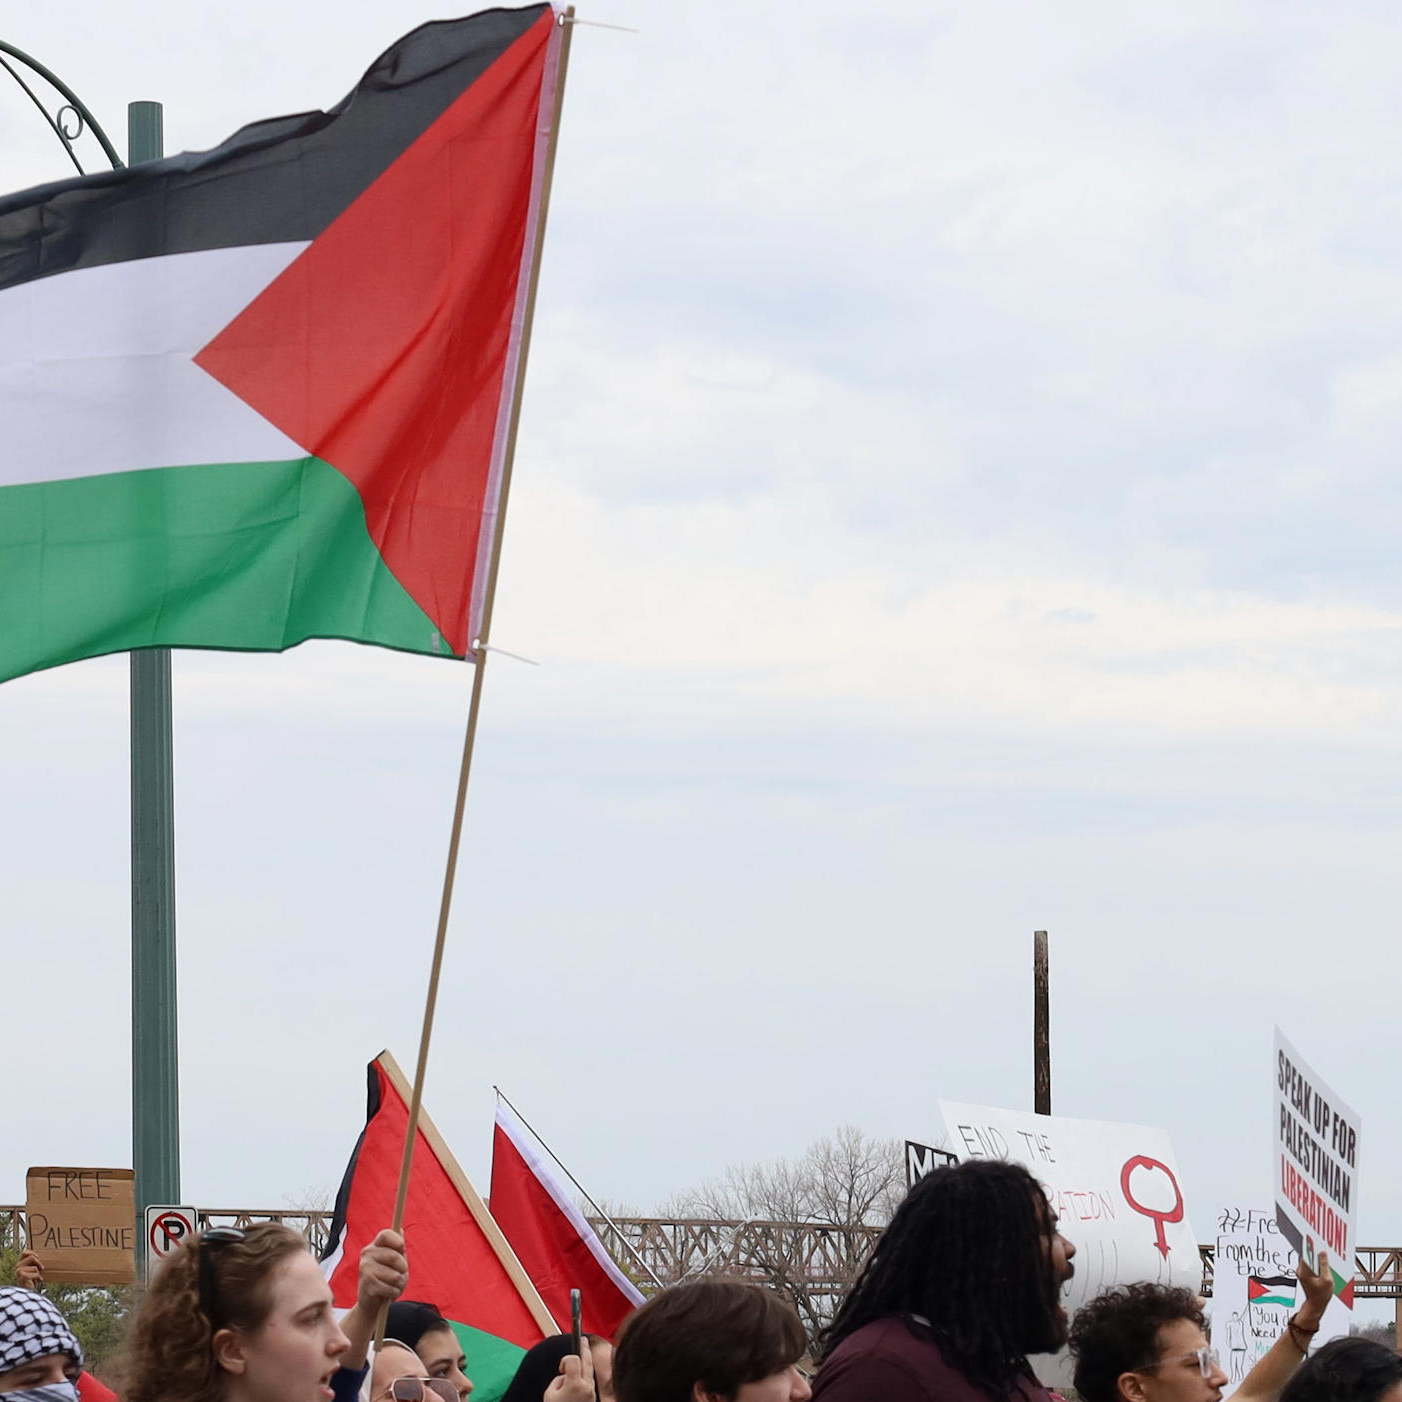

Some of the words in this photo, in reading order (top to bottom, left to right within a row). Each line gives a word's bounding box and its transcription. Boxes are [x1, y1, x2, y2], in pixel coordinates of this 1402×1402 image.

[958, 1125, 1009, 1160] END
[1016, 1130, 1056, 1163] THE
[1278, 1049, 1312, 1124] SPEAK
[1313, 1089, 1330, 1140] UP
[1332, 1109, 1356, 1169] FOR
[47, 1171, 113, 1201] FREE
[1280, 1102, 1351, 1215] PALESTINIAN
[28, 1213, 135, 1250] PALESTINE
[1281, 1153, 1348, 1261] LIBERATION!
